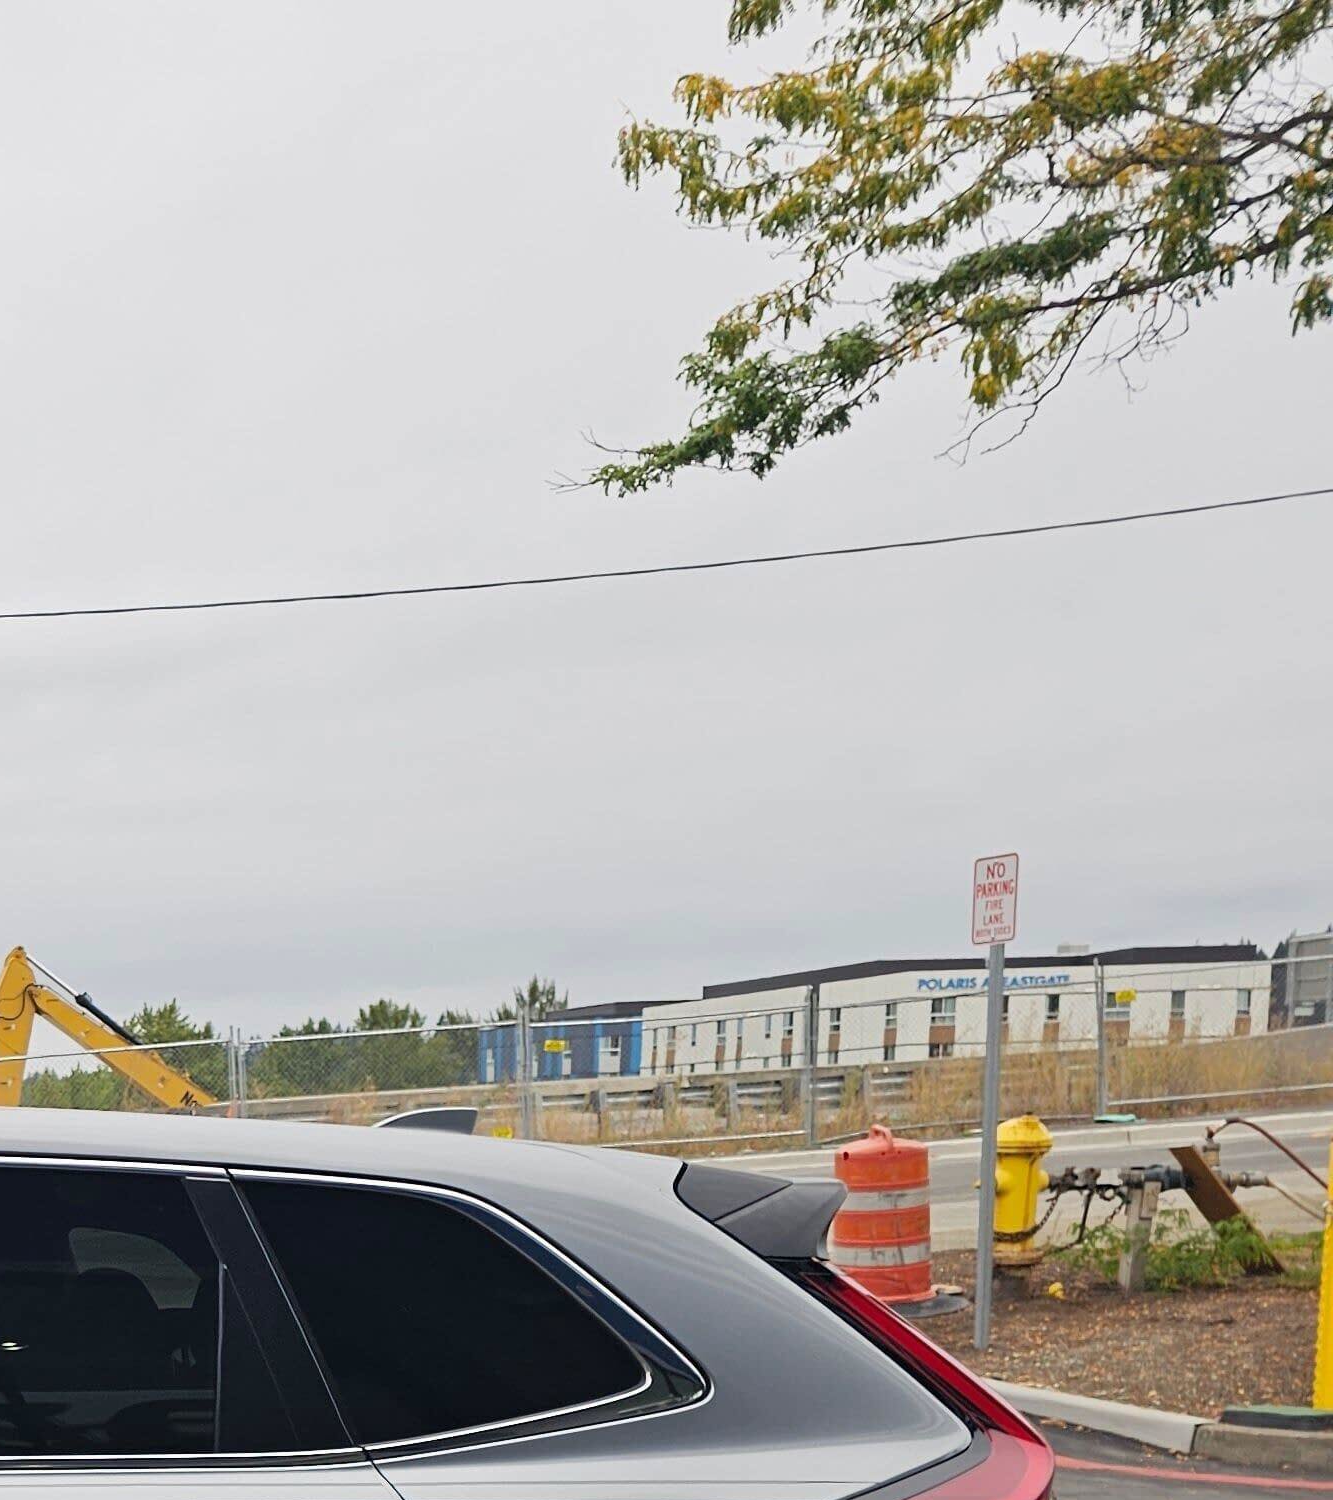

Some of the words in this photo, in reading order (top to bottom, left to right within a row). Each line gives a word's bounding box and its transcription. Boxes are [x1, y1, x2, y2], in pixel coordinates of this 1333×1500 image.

[986, 862, 1005, 880] NO
[976, 879, 1014, 898] PARKING
[985, 899, 1004, 911] FIRE
[983, 913, 1005, 926] LANE
[917, 976, 977, 990] POLARIS
[1003, 975, 1070, 987] EASTGATE
